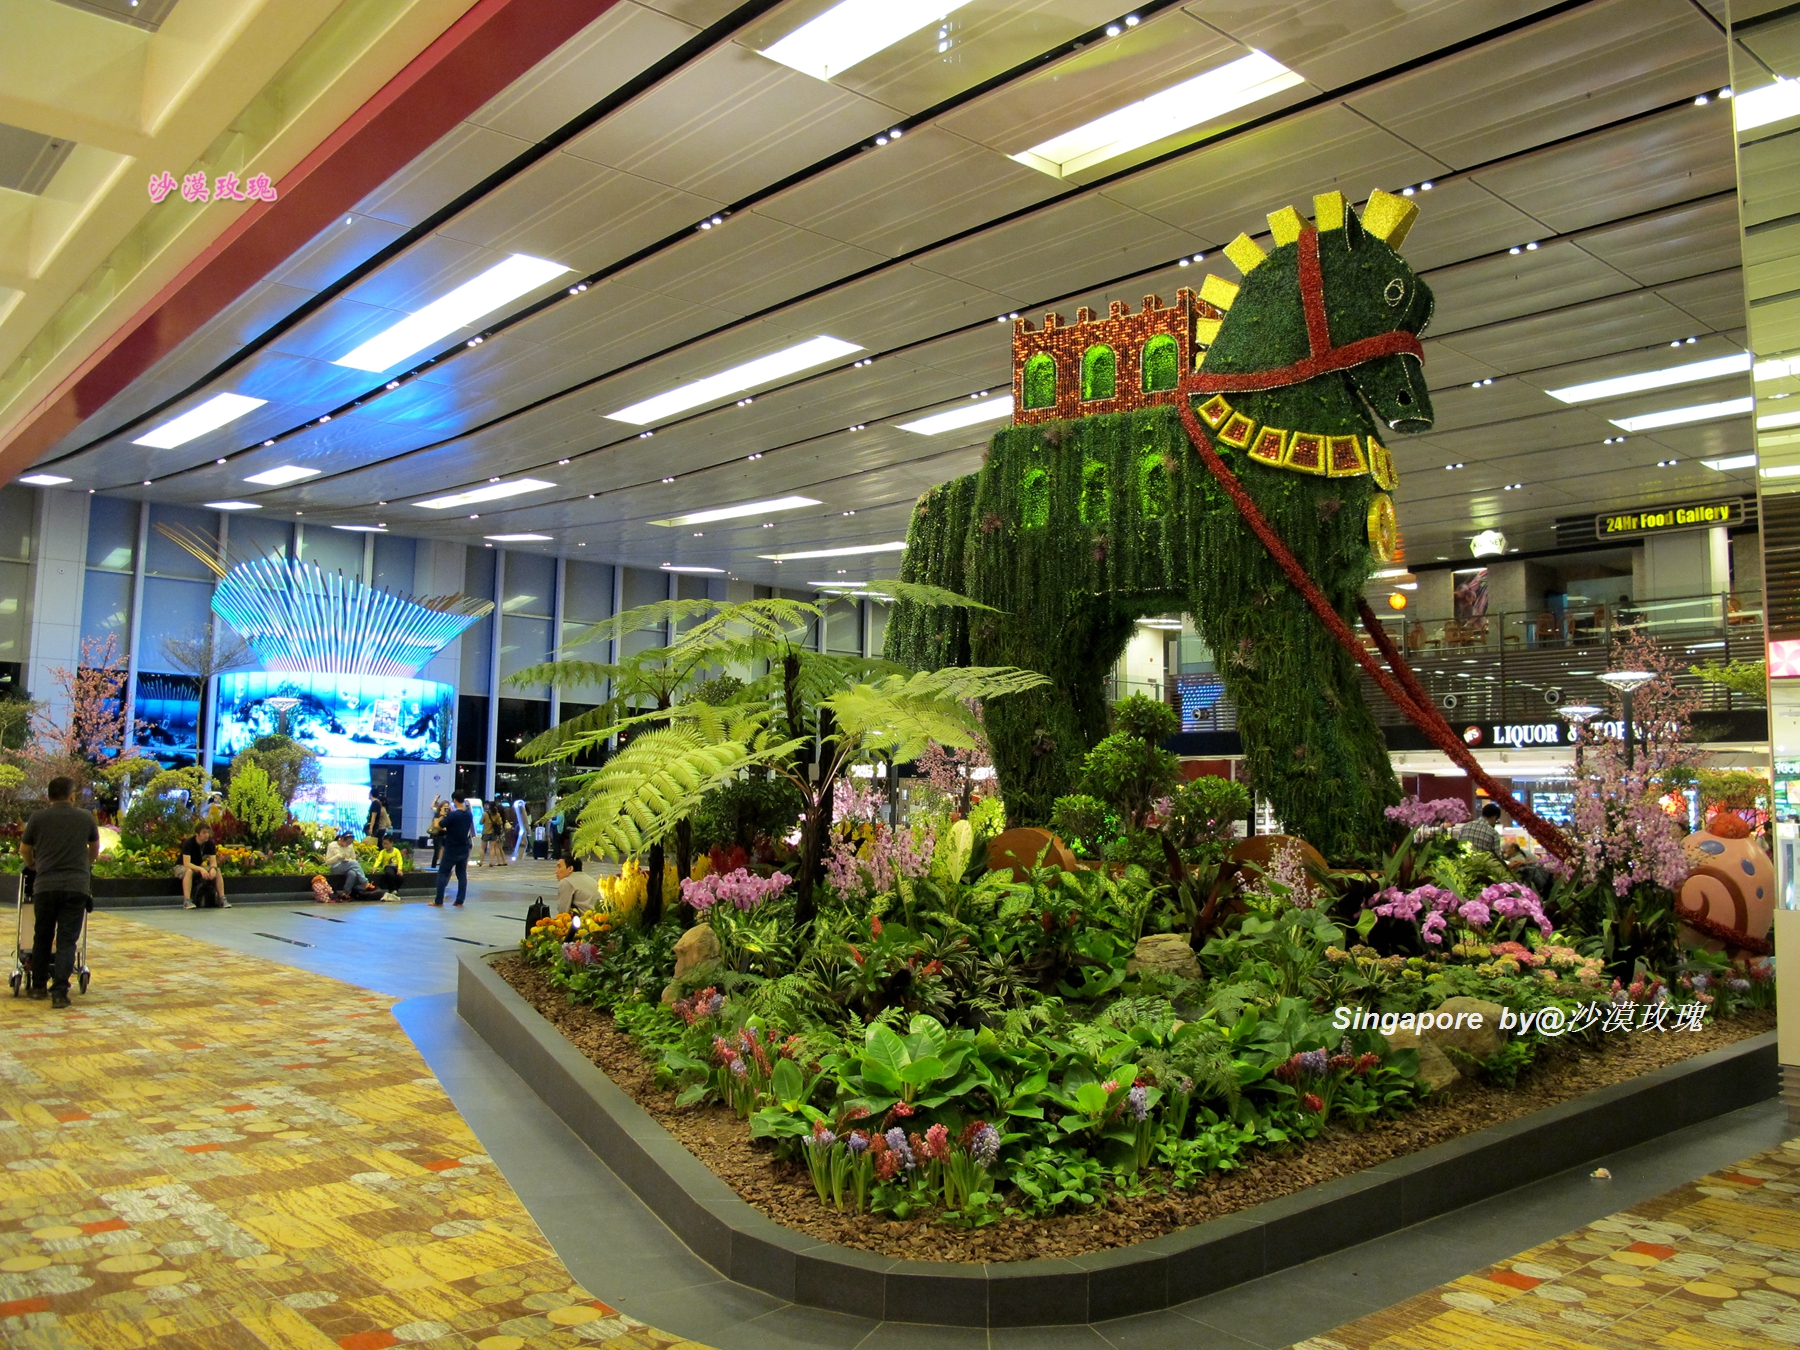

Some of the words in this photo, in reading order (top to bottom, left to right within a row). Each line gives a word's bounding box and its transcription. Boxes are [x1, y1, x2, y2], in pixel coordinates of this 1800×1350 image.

[1606, 514, 1638, 532] 24Hr
[1640, 510, 1674, 528] Food
[1676, 505, 1729, 524] Gallery
[1493, 724, 1558, 747] LIQUOR
